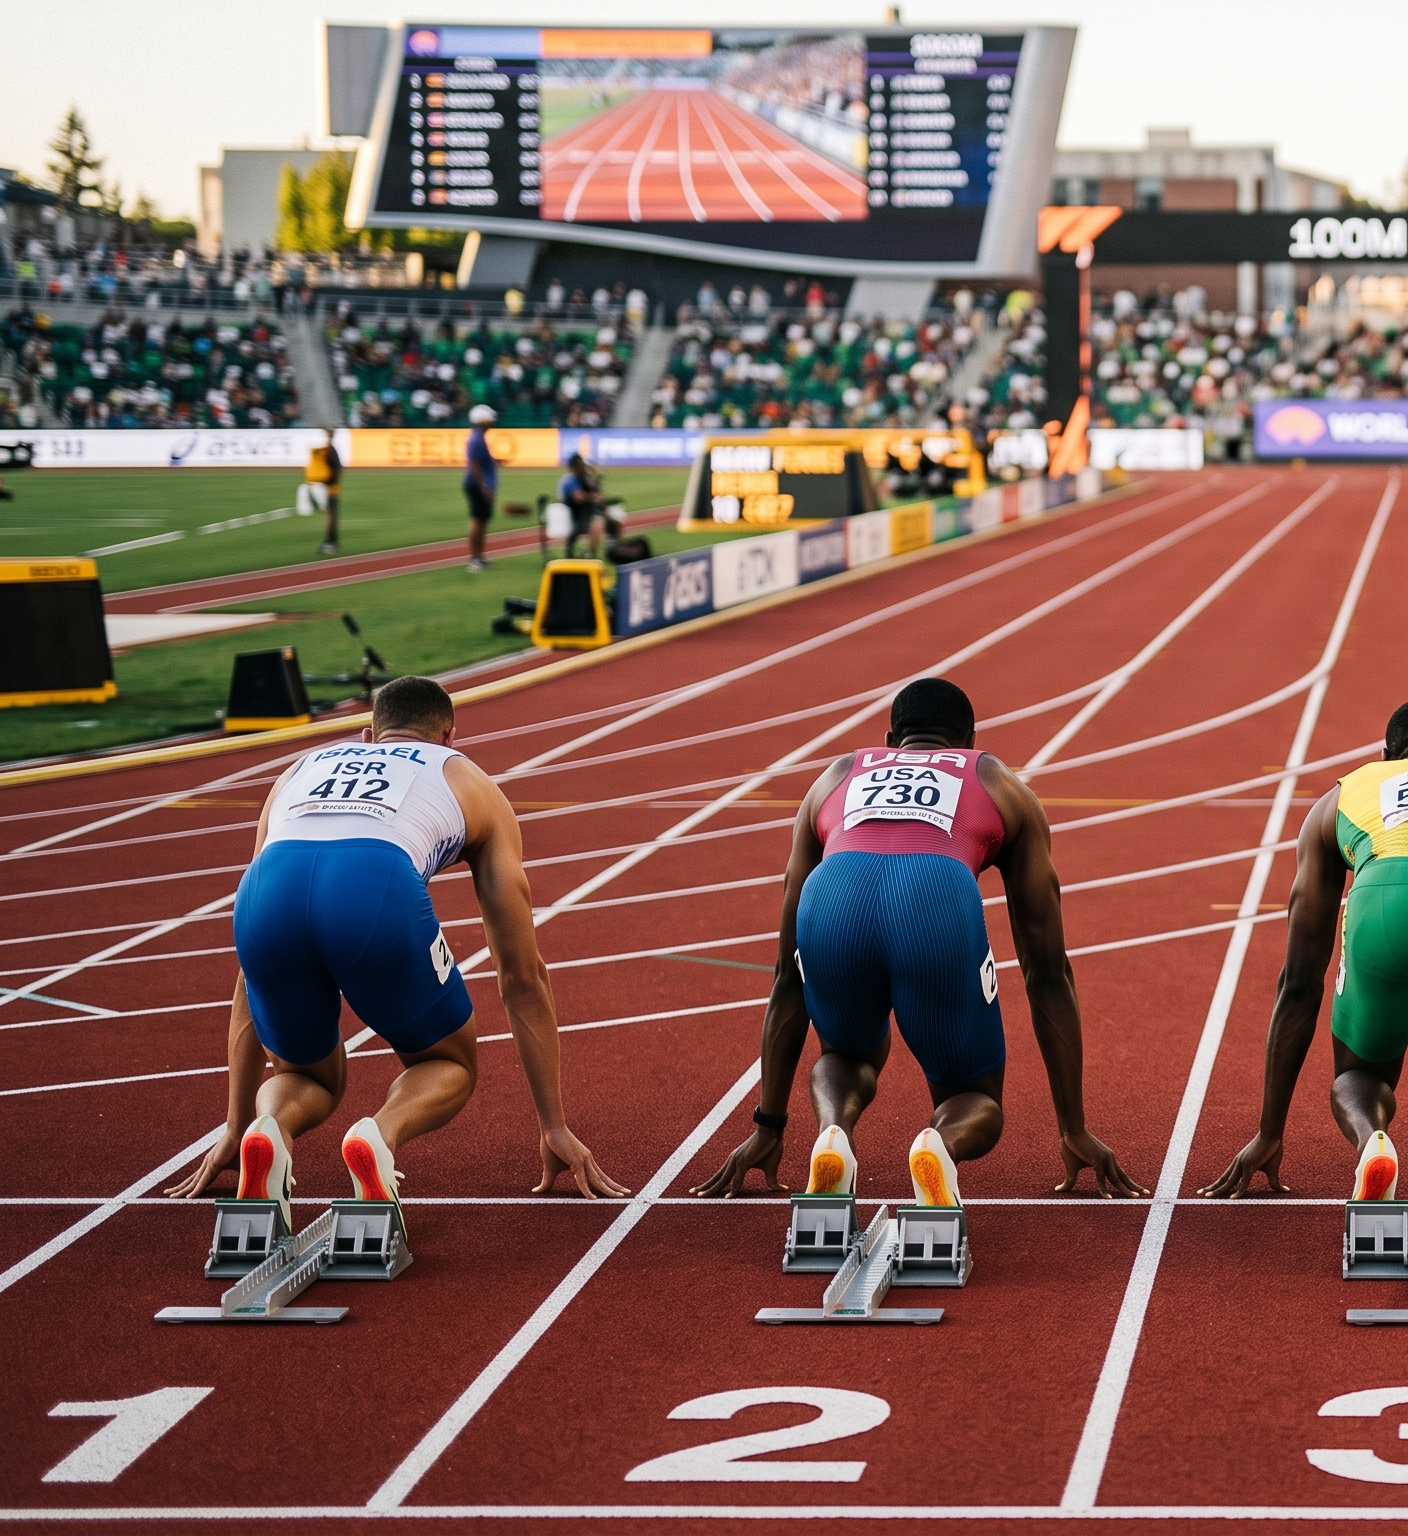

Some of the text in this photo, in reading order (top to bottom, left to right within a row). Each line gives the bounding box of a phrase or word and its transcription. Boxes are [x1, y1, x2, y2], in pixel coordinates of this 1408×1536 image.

[1289, 217, 1408, 258] 100M
[314, 747, 426, 765] ISRAEL
[861, 752, 967, 769] USA
[331, 761, 387, 775] ISR
[870, 768, 939, 783] USA
[308, 778, 390, 801] 412
[861, 784, 941, 807] 730
[41, 1387, 214, 1482] 1
[624, 1386, 891, 1482] 2
